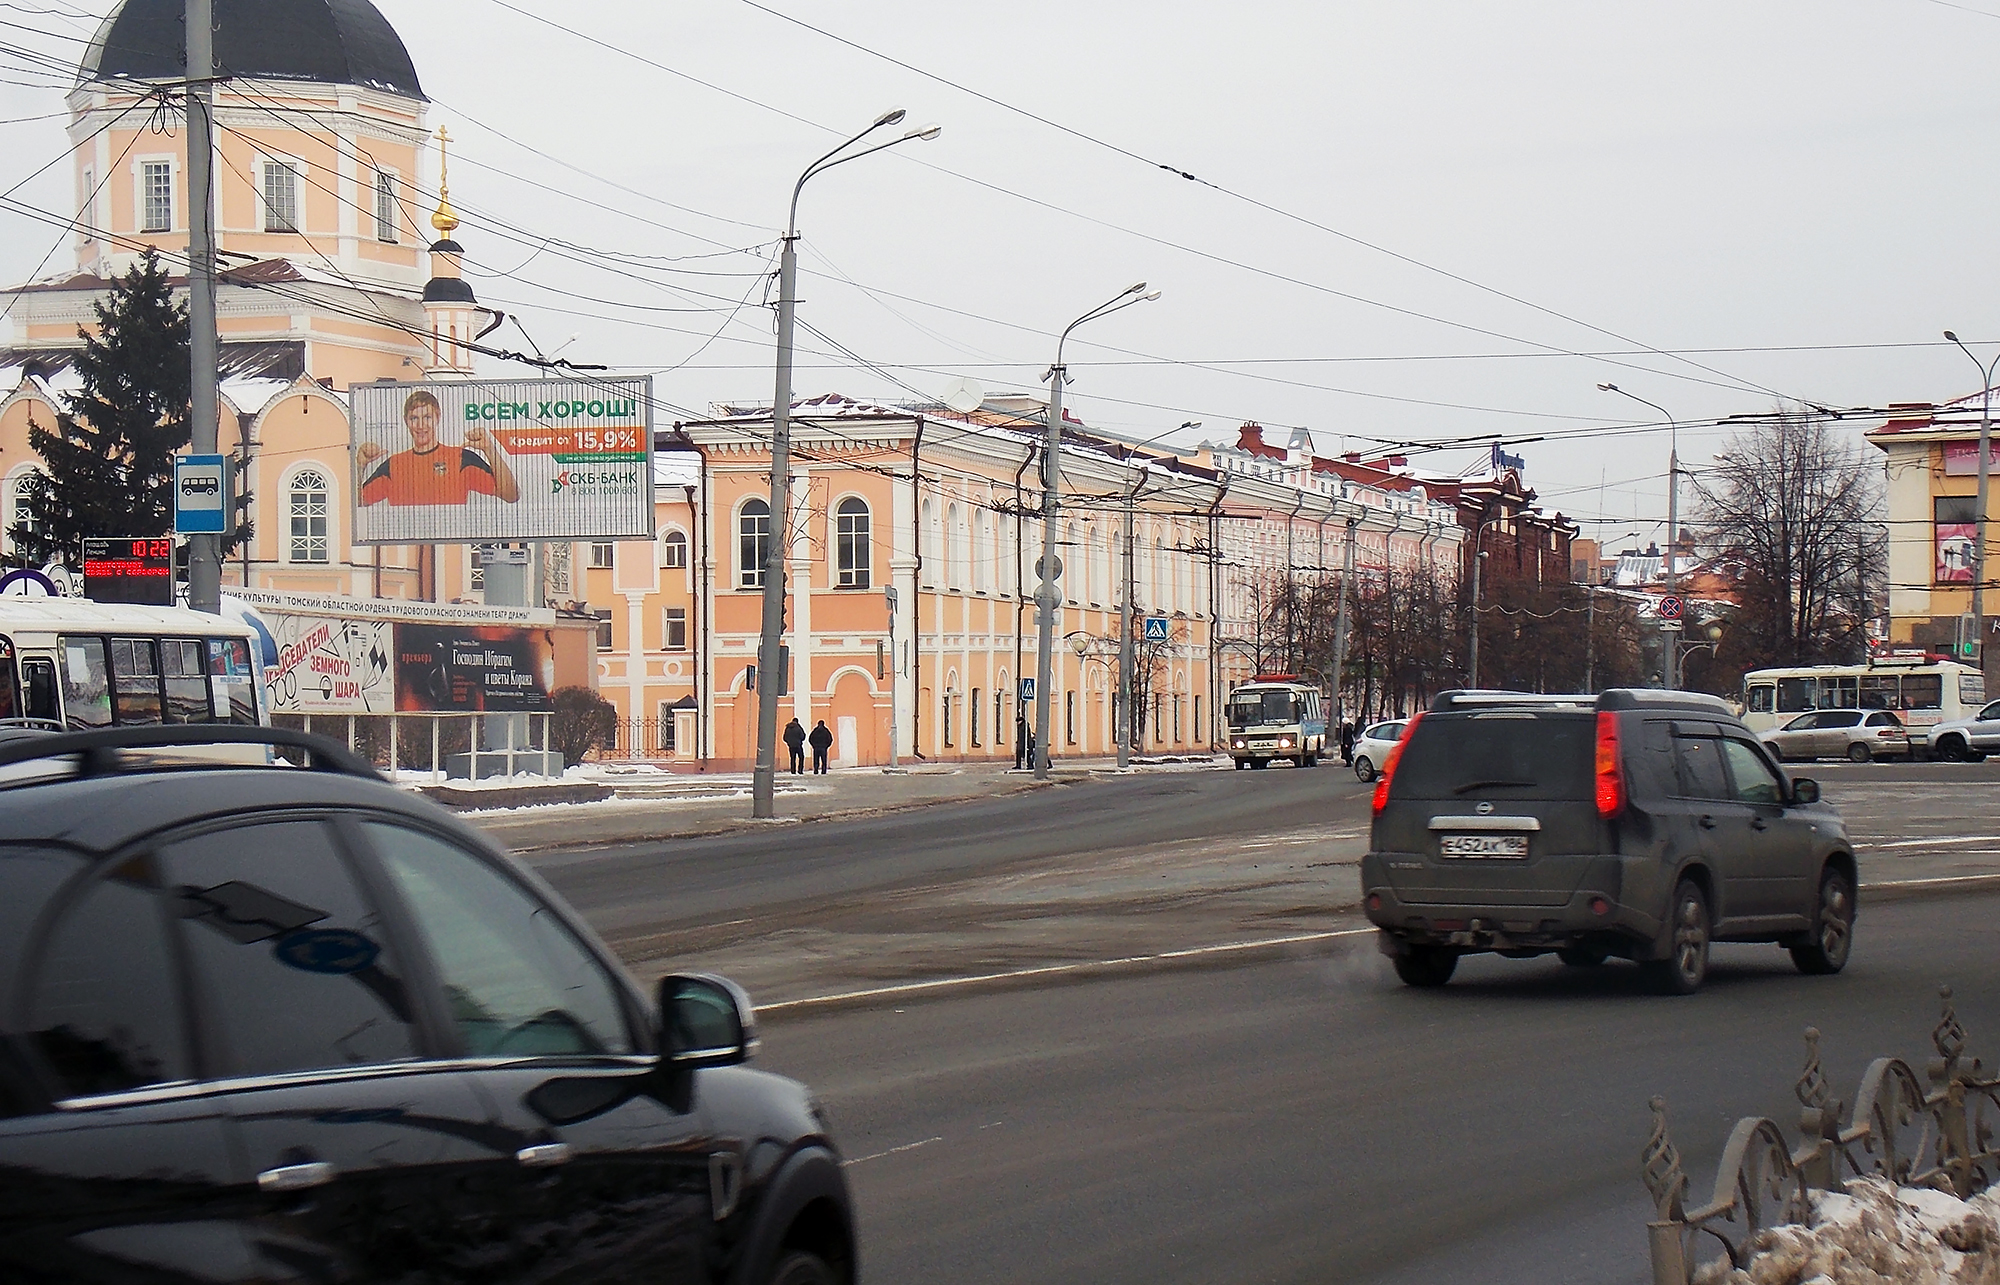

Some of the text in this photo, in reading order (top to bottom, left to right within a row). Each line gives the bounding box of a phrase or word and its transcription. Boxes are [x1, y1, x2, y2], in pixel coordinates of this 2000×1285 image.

[464, 399, 636, 421] ВСЕМ ХОРОШ!
[509, 436, 554, 448] Кредит
[574, 430, 636, 451] 15,9%
[569, 471, 637, 485] СКБ-БАНК
[243, 592, 281, 604] КУЛЬТУРЫ
[322, 600, 364, 612] ОБЛАСТНОЙ
[364, 603, 390, 614] ОРДЕНА
[391, 605, 429, 617] ТРУДОВОГО
[429, 608, 462, 618] КРАСНОГО
[462, 609, 490, 619] ЗНАМЕНИ
[491, 610, 508, 619] ТЕАТР
[310, 655, 350, 677] ЗЕМНОГО
[335, 681, 360, 699] ШАРА
